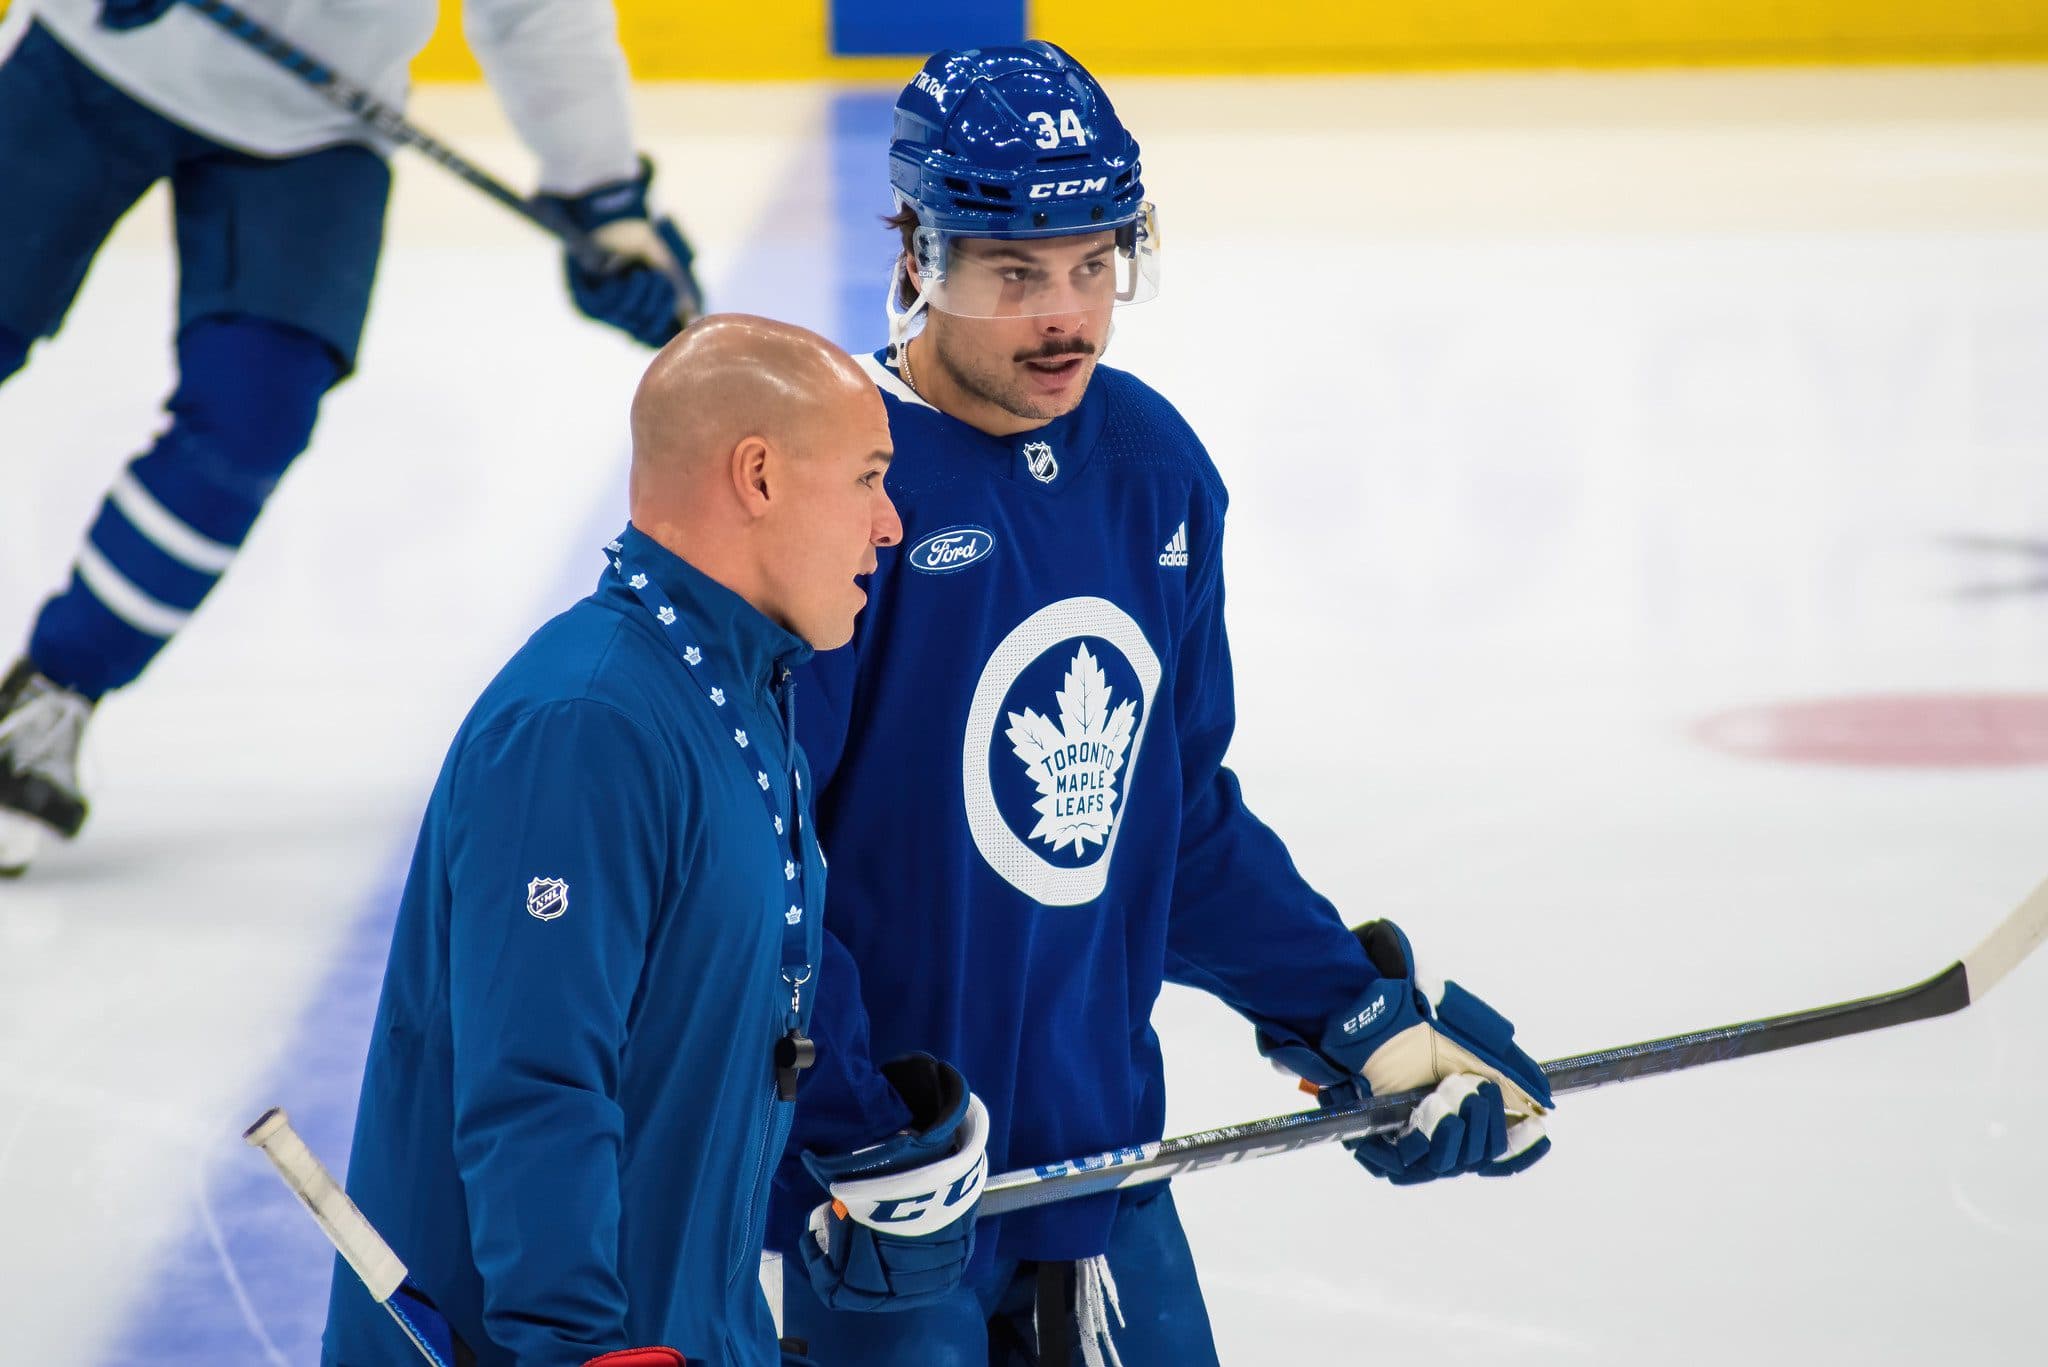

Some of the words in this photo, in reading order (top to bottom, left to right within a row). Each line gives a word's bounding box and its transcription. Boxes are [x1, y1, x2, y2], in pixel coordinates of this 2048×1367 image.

[915, 72, 949, 103] TikTok
[1027, 109, 1087, 150] 34
[1029, 176, 1108, 199] CCM
[926, 535, 977, 566] Ford
[1158, 551, 1189, 567] adidas
[1041, 742, 1114, 777] TORONTO
[1056, 770, 1105, 793] MAPLE
[1056, 793, 1104, 817] LEAFS
[1343, 994, 1385, 1032] CCM
[869, 1152, 985, 1223] CC
